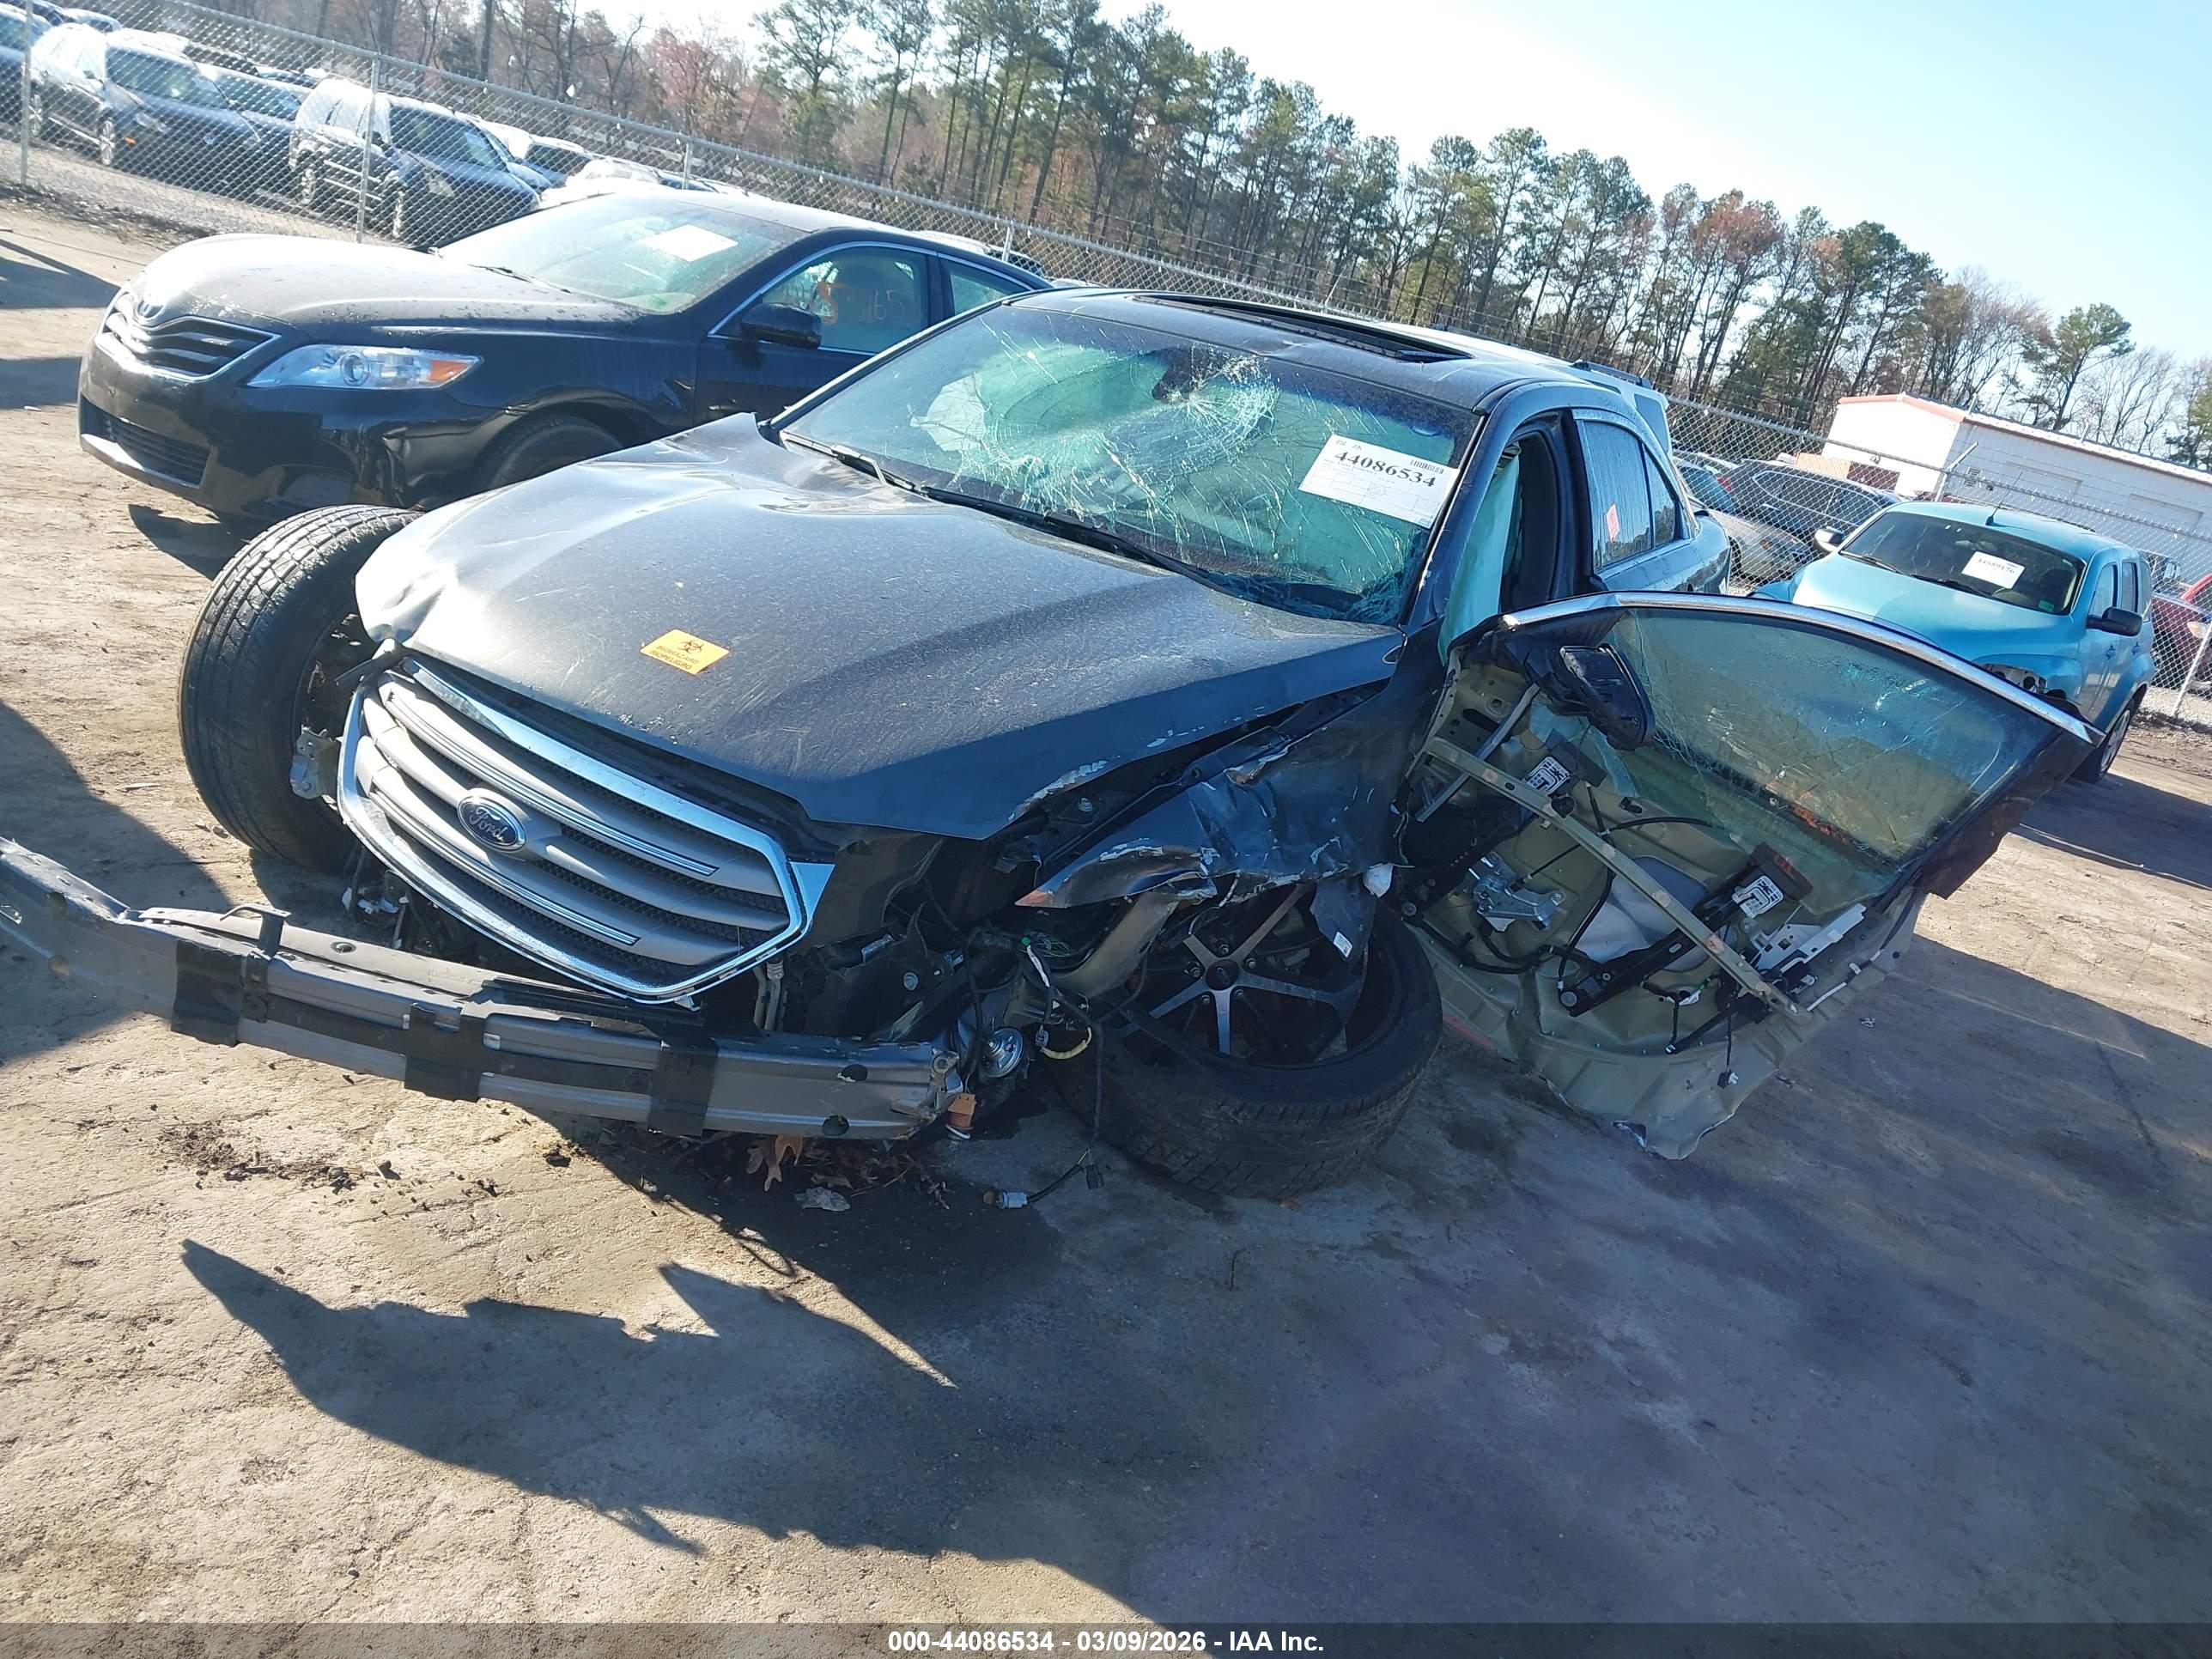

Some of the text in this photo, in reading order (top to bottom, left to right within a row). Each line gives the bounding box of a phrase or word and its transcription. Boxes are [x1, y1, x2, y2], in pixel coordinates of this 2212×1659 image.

[1334, 451, 1437, 488] 44086534
[650, 648, 693, 670] BIOPELIGRO
[656, 645, 699, 665] BIOHAZARD
[469, 806, 508, 842] Ford
